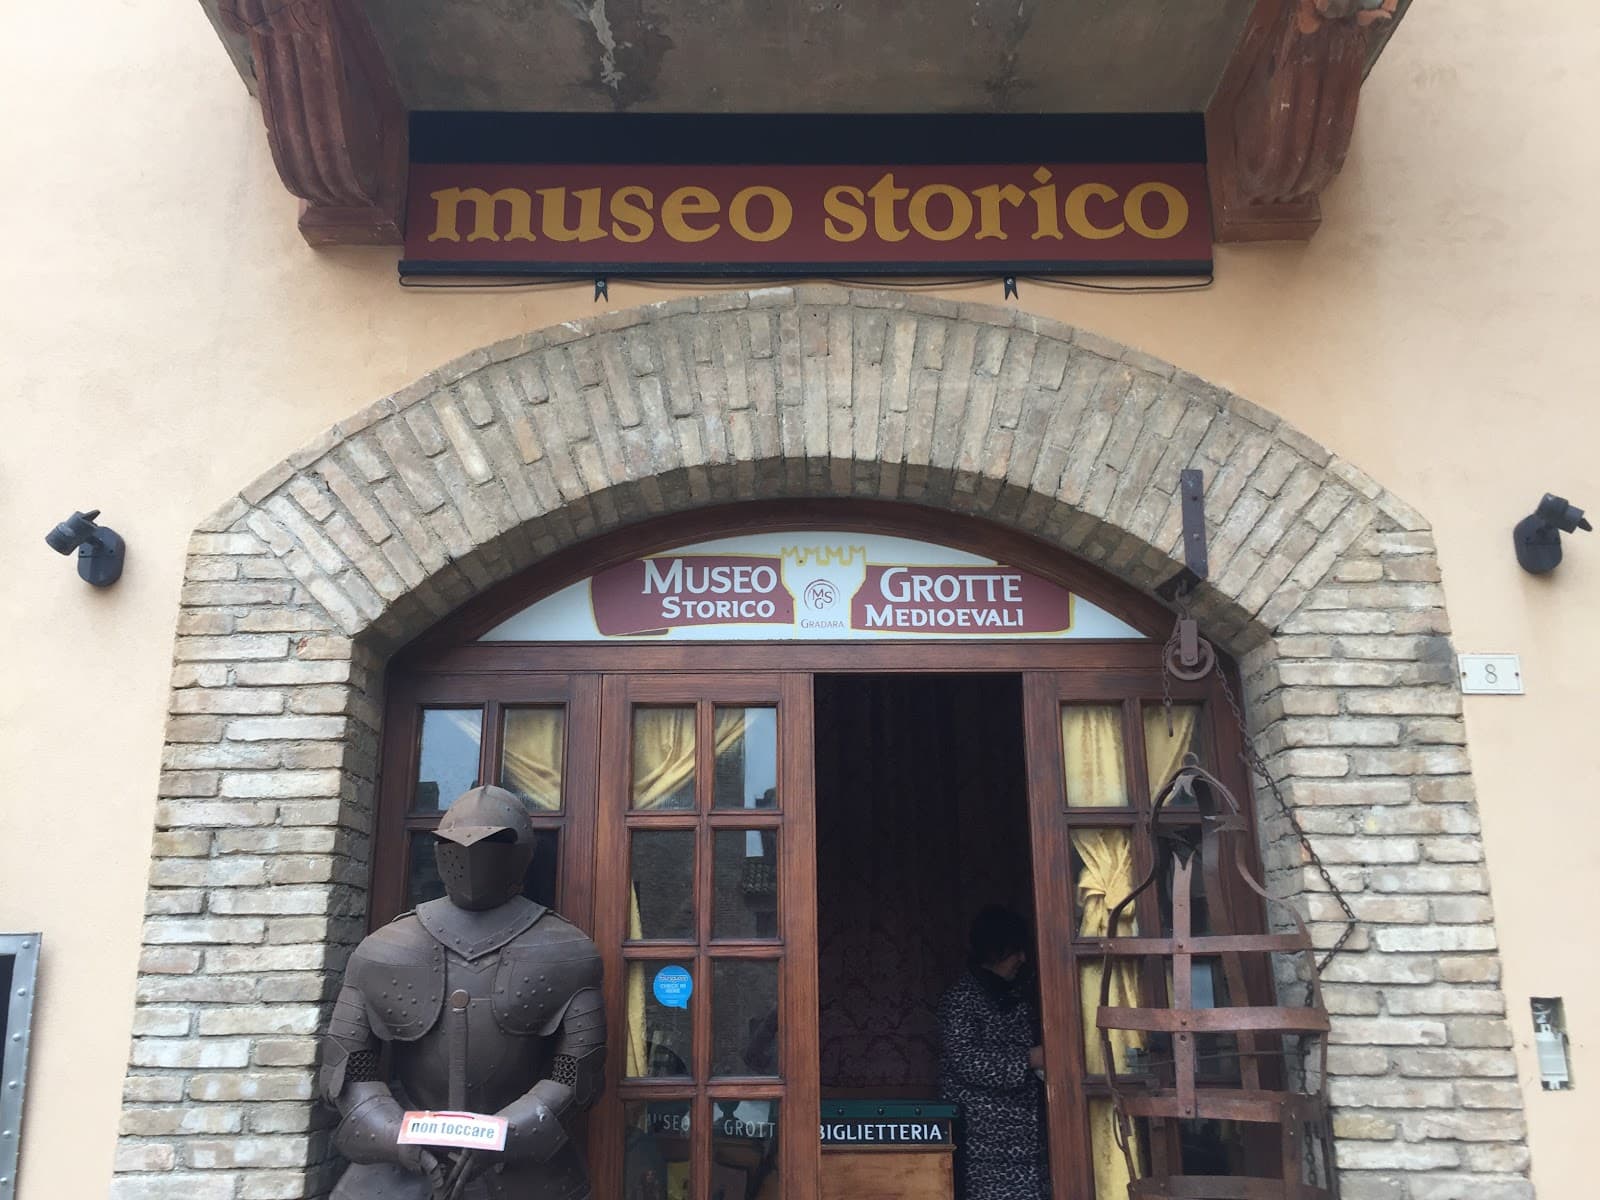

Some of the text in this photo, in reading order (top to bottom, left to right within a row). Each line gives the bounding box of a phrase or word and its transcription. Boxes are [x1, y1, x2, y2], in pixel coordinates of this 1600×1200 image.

[427, 165, 1190, 243] museo storico
[641, 558, 778, 594] MUSEO
[879, 567, 1023, 602] GROTTE
[661, 596, 776, 619] STORICO
[864, 604, 1024, 627] MEDIOEVALI
[800, 618, 845, 629] GRADARA
[1484, 663, 1498, 684] 8
[411, 1122, 495, 1139] non toccare
